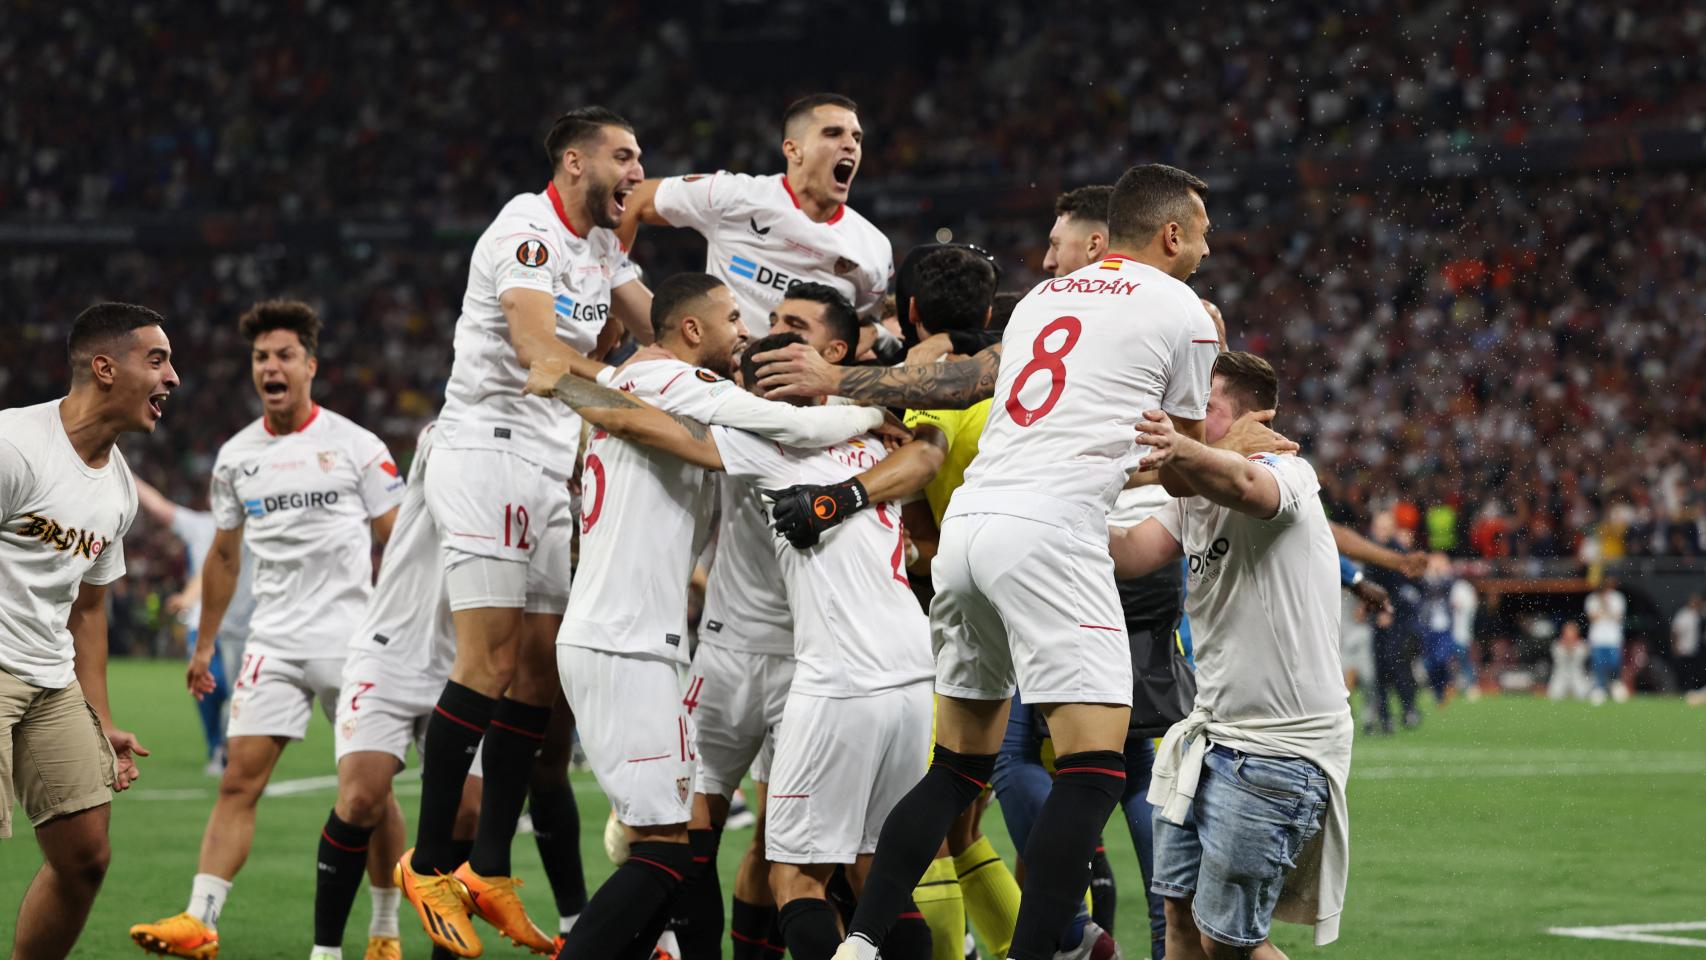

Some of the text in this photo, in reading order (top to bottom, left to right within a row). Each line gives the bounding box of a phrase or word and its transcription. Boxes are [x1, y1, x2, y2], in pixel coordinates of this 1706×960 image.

[1038, 278, 1141, 295] JORDÁN
[1005, 316, 1082, 427] 8
[264, 491, 338, 513] DEGIRO
[504, 503, 529, 549] 12
[683, 675, 704, 715] 4
